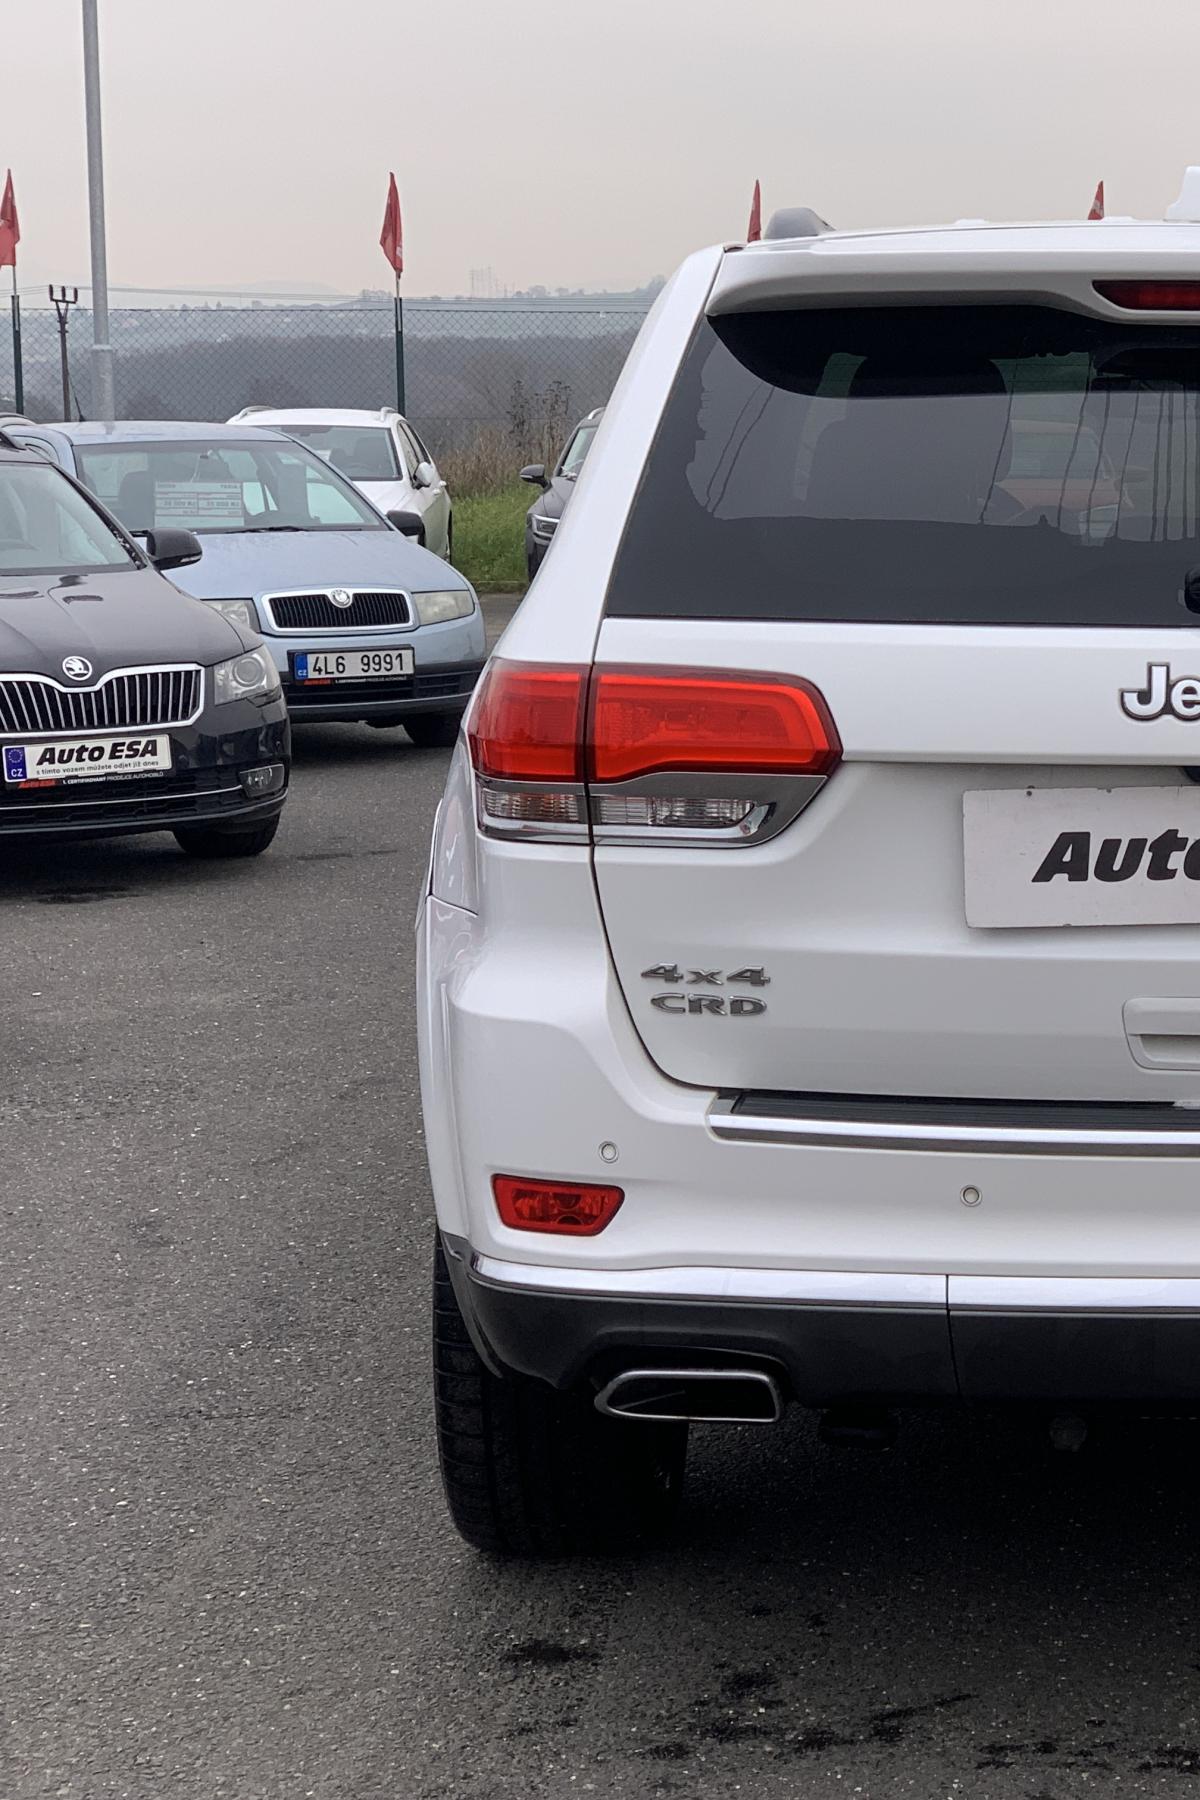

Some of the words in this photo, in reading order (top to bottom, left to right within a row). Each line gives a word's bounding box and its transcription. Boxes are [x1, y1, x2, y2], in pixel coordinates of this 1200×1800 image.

[312, 655, 346, 675] 4L6
[360, 653, 404, 673] 9991
[36, 744, 106, 766] Auto
[108, 739, 158, 760] ESA
[10, 768, 23, 778] CZ
[62, 766, 85, 774] vozem
[113, 762, 131, 770] odjet
[650, 992, 768, 1017] CRD
